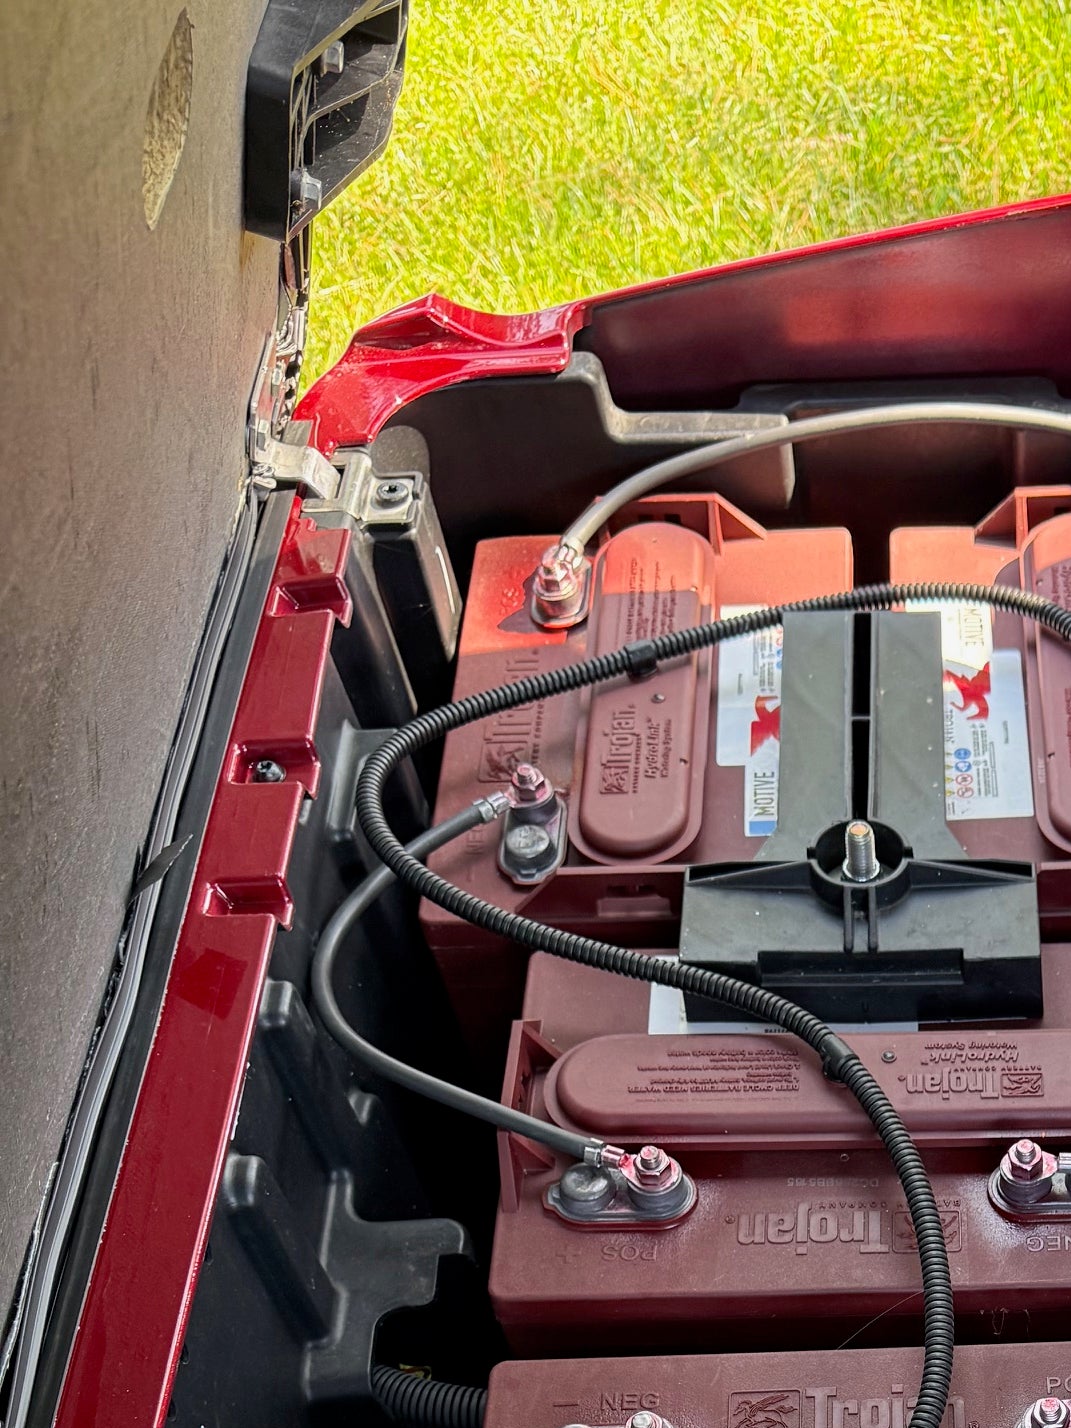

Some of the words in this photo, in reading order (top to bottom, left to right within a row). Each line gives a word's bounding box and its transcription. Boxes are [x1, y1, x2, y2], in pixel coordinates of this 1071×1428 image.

[964, 609, 984, 647] MOTIVE
[600, 711, 640, 766] Trojan
[753, 771, 775, 816] MOTIVE
[930, 1049, 1018, 1065] HydroLink
[906, 1068, 1000, 1100] Trojan
[735, 1201, 889, 1256] Trojan
[600, 1244, 656, 1261] POS
[600, 1393, 661, 1410] NEG
